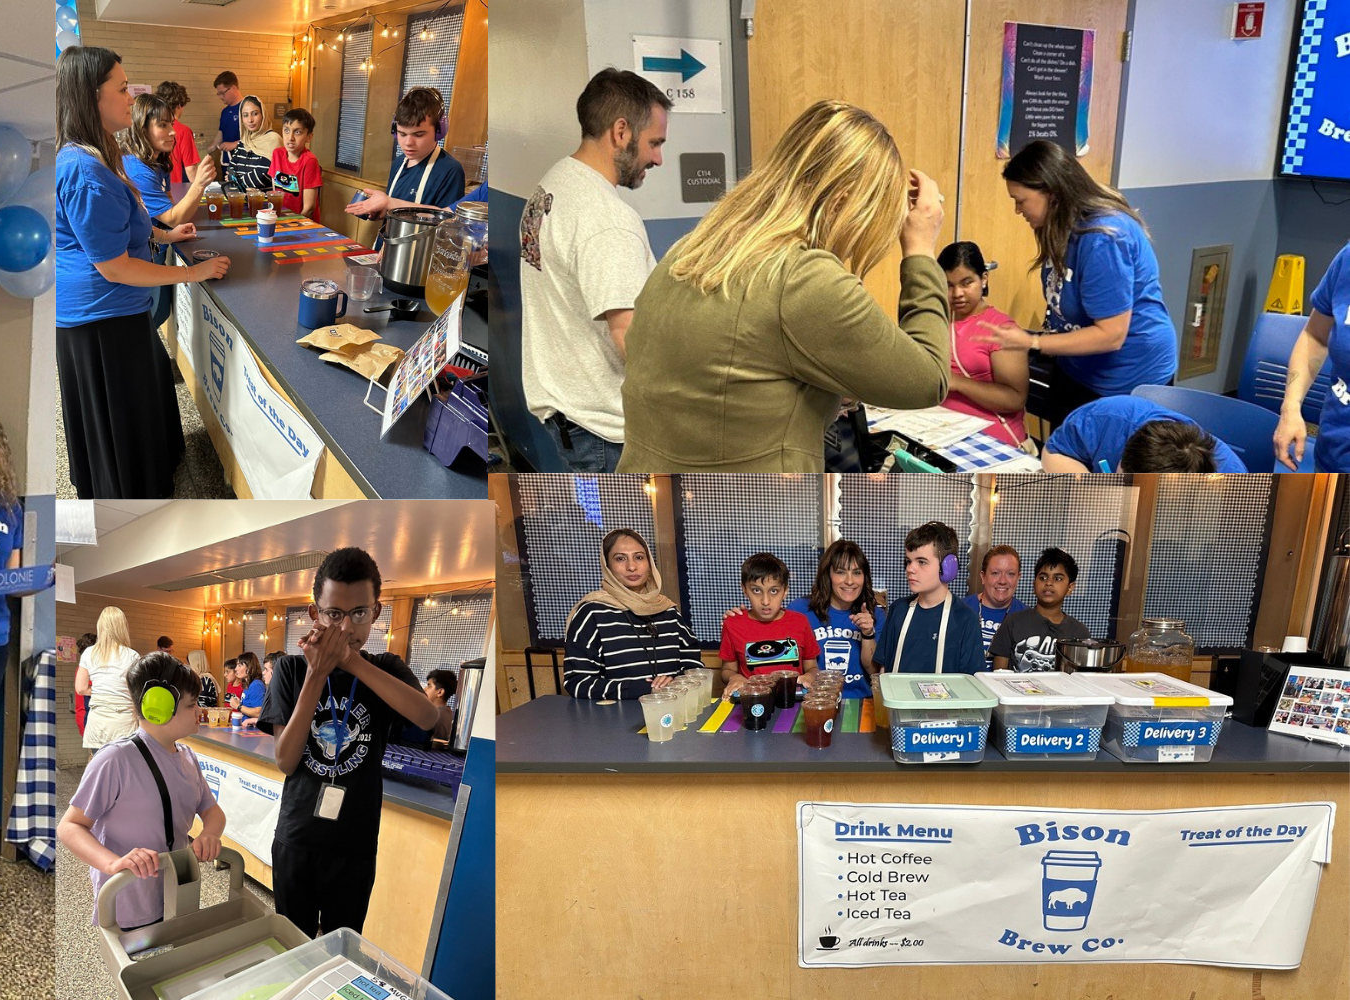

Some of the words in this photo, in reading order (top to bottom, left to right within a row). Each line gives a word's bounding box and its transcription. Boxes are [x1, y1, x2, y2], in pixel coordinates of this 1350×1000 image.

[666, 88, 673, 98] C
[677, 88, 695, 98] 158
[1318, 118, 1350, 142] Bre
[202, 303, 234, 352] Bison
[243, 365, 257, 397] Treat
[257, 394, 267, 410] of
[269, 405, 286, 430] the
[287, 426, 310, 458] Day
[980, 617, 1002, 631] iso
[814, 626, 862, 641] Bison
[316, 695, 371, 731] AKER
[912, 732, 964, 748] Delivery
[968, 732, 973, 743] 1
[1021, 733, 1073, 749] Delivery
[1075, 734, 1084, 746] 2
[1144, 726, 1196, 743] Delivery
[1197, 727, 1206, 738] 3
[199, 761, 227, 778] Bison
[238, 777, 251, 788] Treat
[251, 783, 258, 791] of
[257, 785, 267, 795] the
[267, 789, 281, 800] Day
[835, 821, 891, 836] Drink
[897, 824, 953, 838] Menu
[1014, 821, 1131, 846] Bison
[1180, 829, 1222, 840] Treat
[1225, 826, 1244, 838] of
[1246, 826, 1272, 837] the
[1276, 824, 1307, 838] Day
[847, 852, 876, 864] Hot
[881, 853, 932, 864] Coffee
[847, 871, 882, 883] Cold
[888, 871, 930, 882] Brew
[847, 890, 875, 901] Hot
[880, 889, 907, 901] Tea
[847, 907, 880, 919] Iced
[884, 907, 911, 919] Tea
[848, 938, 862, 947] All
[863, 937, 888, 948] drinks
[998, 929, 1072, 955] Brew
[342, 986, 359, 999] iced
[356, 977, 370, 989] hot
[369, 985, 382, 997] tea
